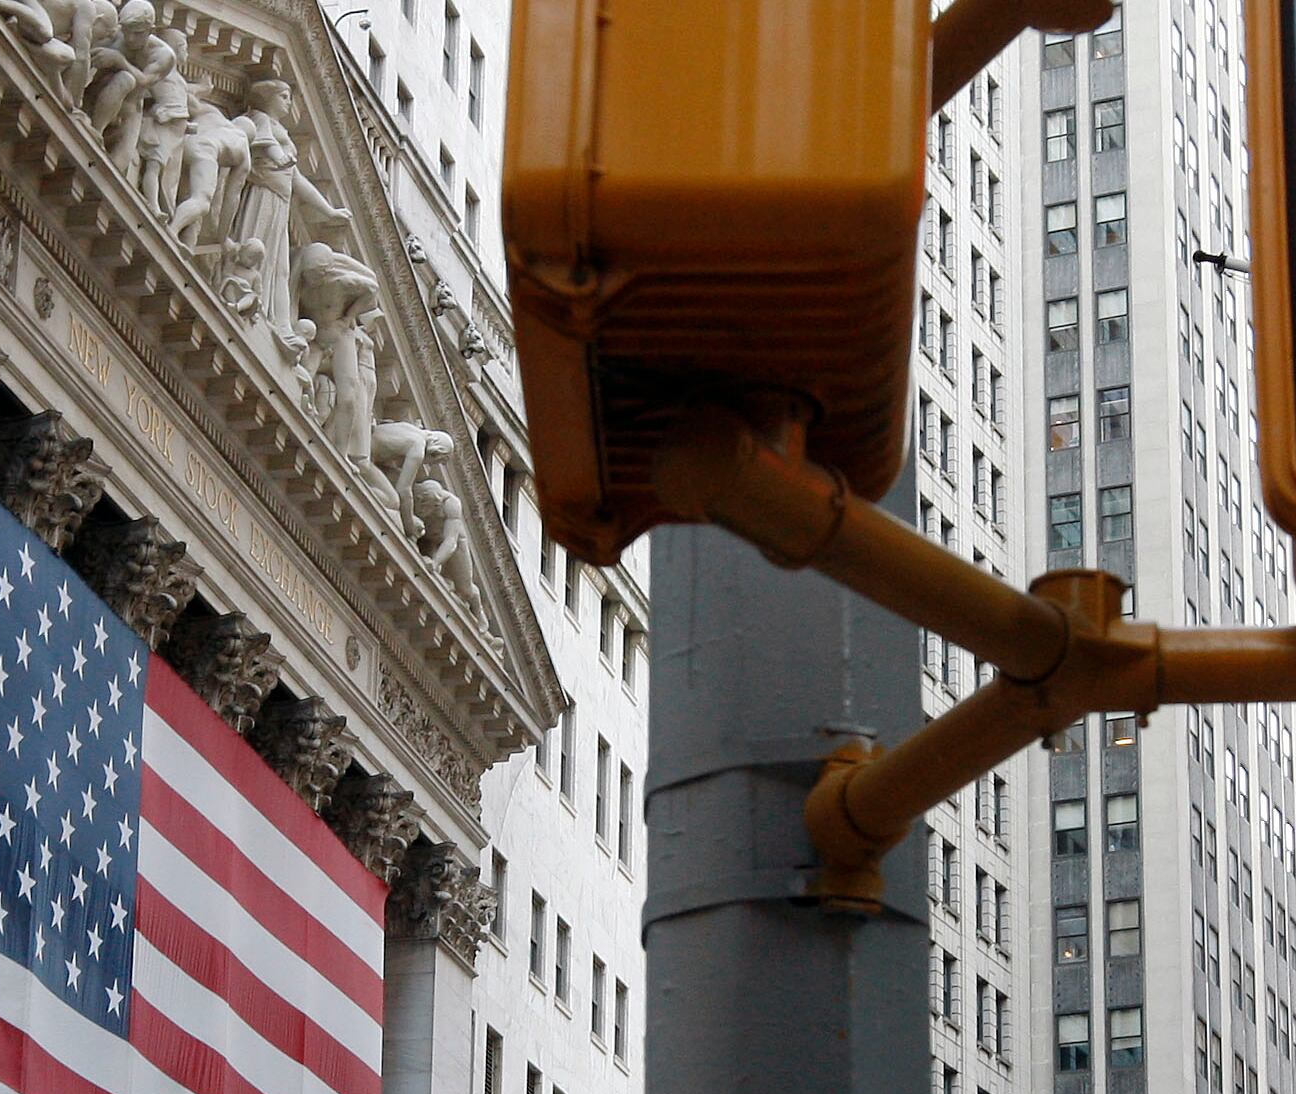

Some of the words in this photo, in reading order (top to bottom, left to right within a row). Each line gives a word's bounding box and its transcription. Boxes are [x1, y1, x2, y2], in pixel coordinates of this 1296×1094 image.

[68, 311, 113, 386] NEW
[122, 373, 176, 467] YORK
[184, 450, 241, 541] STOCK
[249, 518, 334, 645] EXCHANGE
